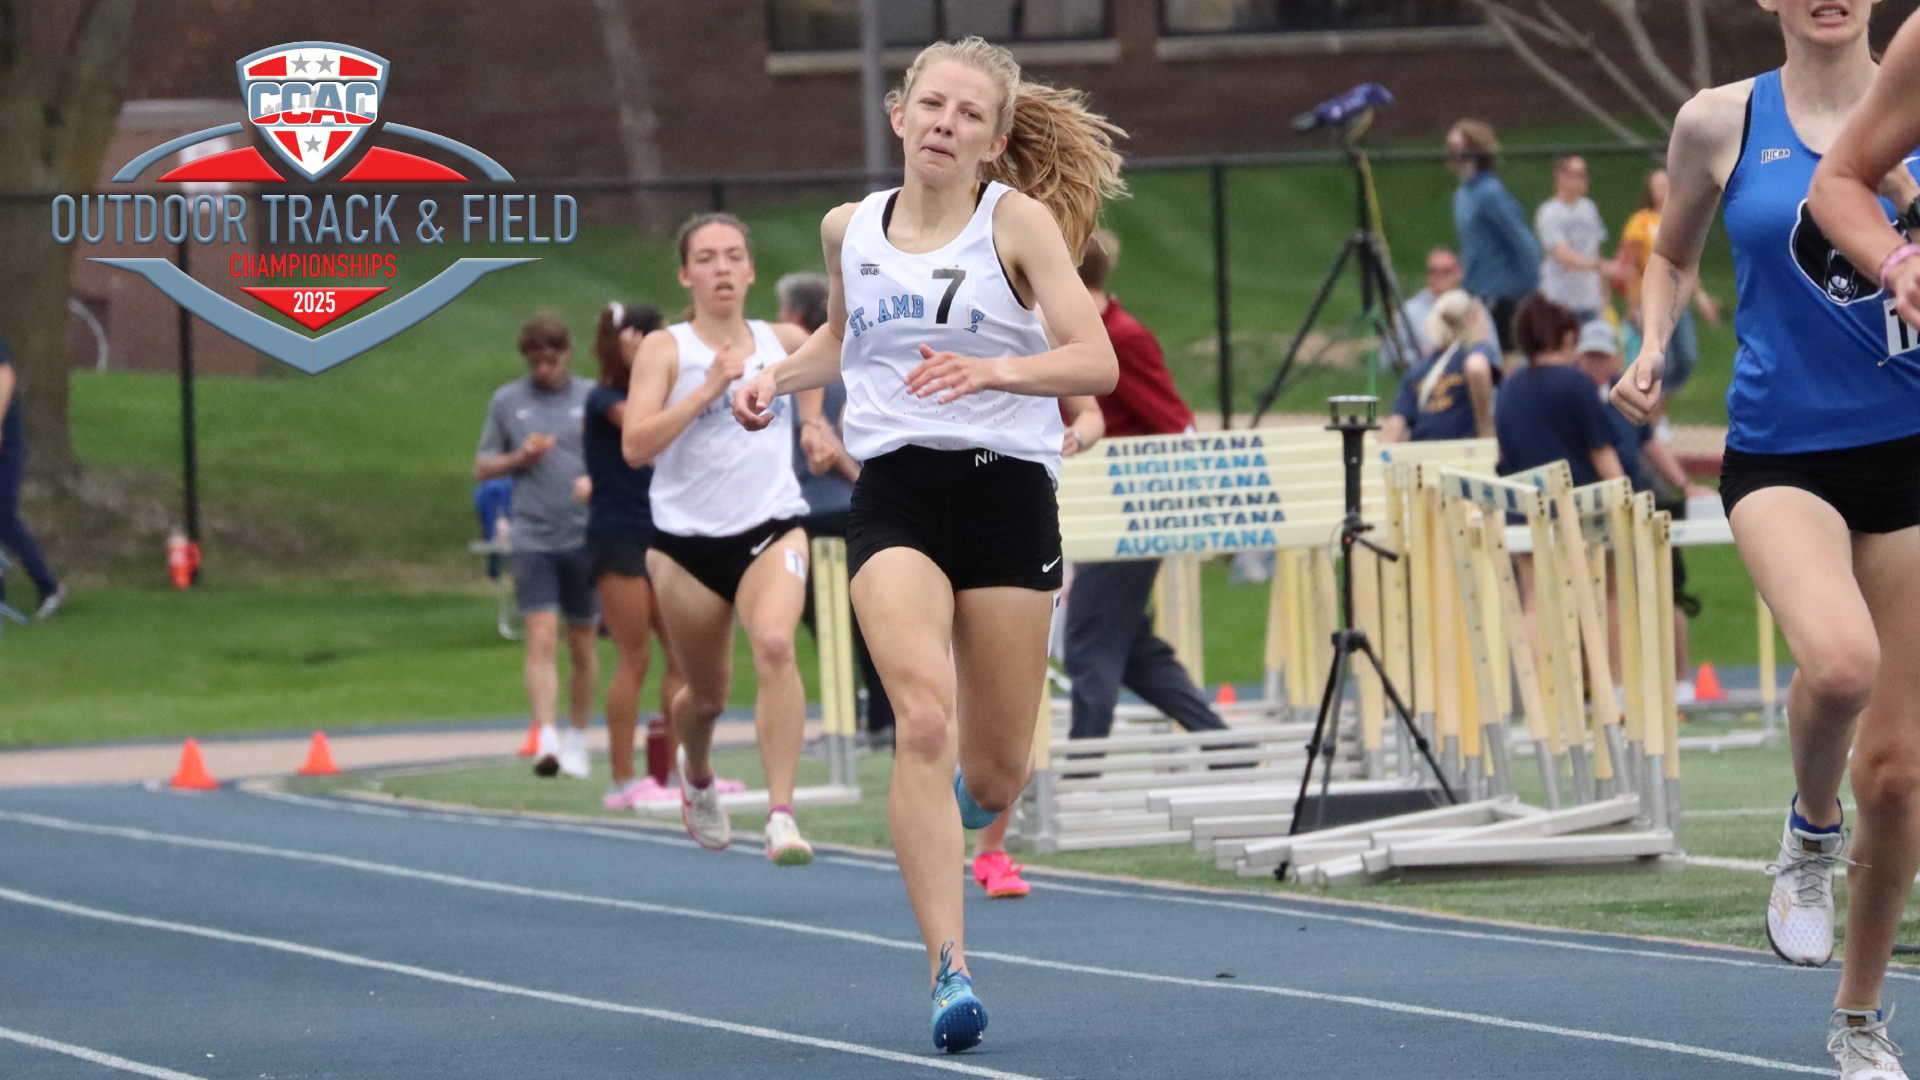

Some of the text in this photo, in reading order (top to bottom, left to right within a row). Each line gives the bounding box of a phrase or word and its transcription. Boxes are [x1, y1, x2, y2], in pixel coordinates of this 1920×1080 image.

[932, 269, 966, 324] 7
[849, 294, 985, 337] ST. AMBE
[1106, 436, 1264, 457] AUGUSTANA
[1108, 454, 1267, 476] AUGUSTANA
[1112, 472, 1271, 495] AUGUSTANA
[1123, 492, 1281, 513] AUGUSTANA
[1128, 510, 1285, 531] AUGUSTANA
[1116, 529, 1276, 555] AUGUSTANA
